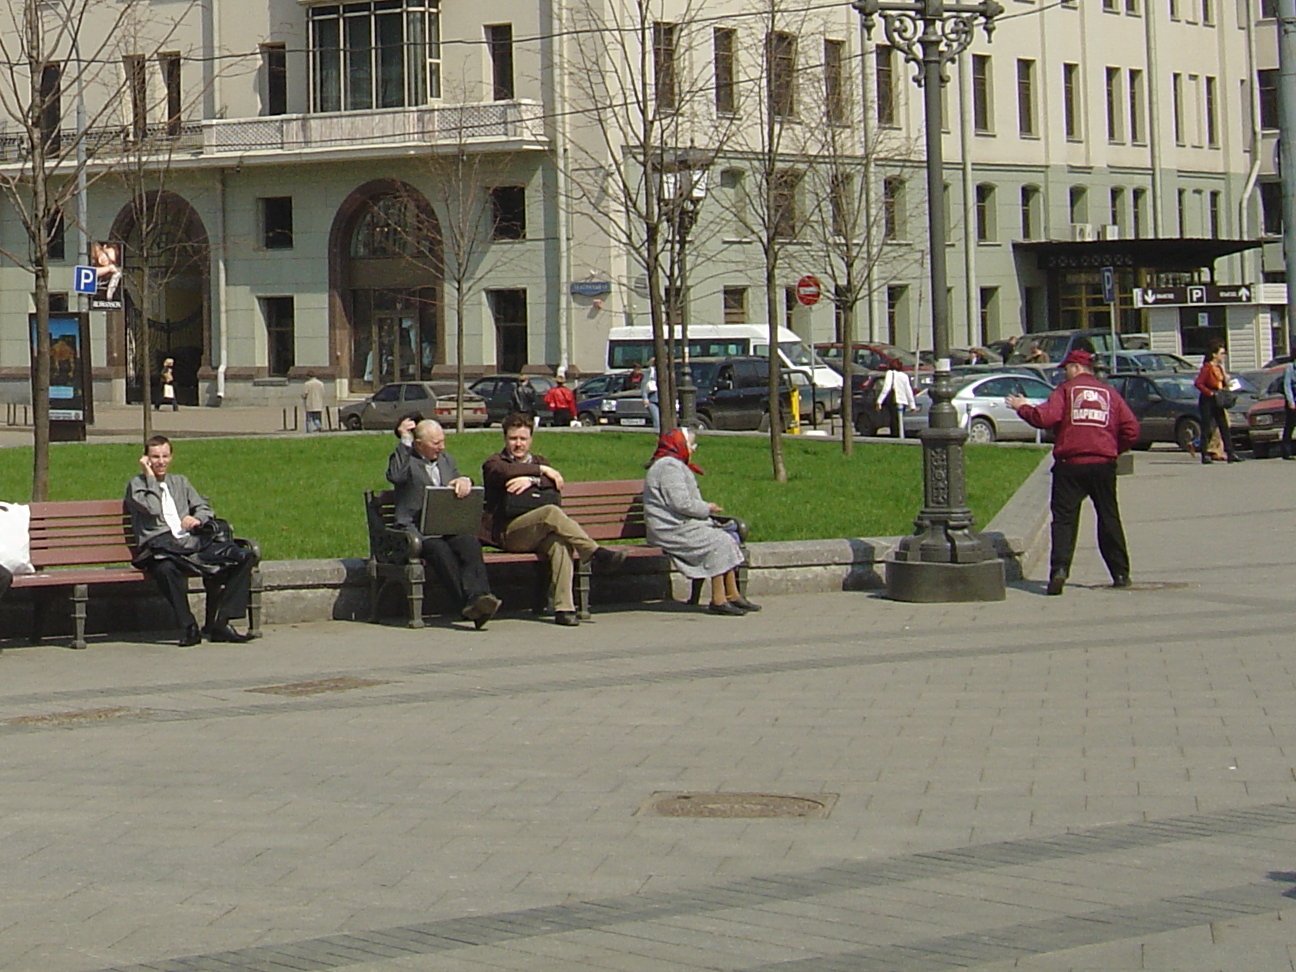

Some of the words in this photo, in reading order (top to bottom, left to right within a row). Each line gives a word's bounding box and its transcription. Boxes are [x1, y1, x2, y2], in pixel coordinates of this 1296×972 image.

[81, 269, 93, 290] P
[1105, 272, 1112, 299] P
[1193, 289, 1202, 301] P
